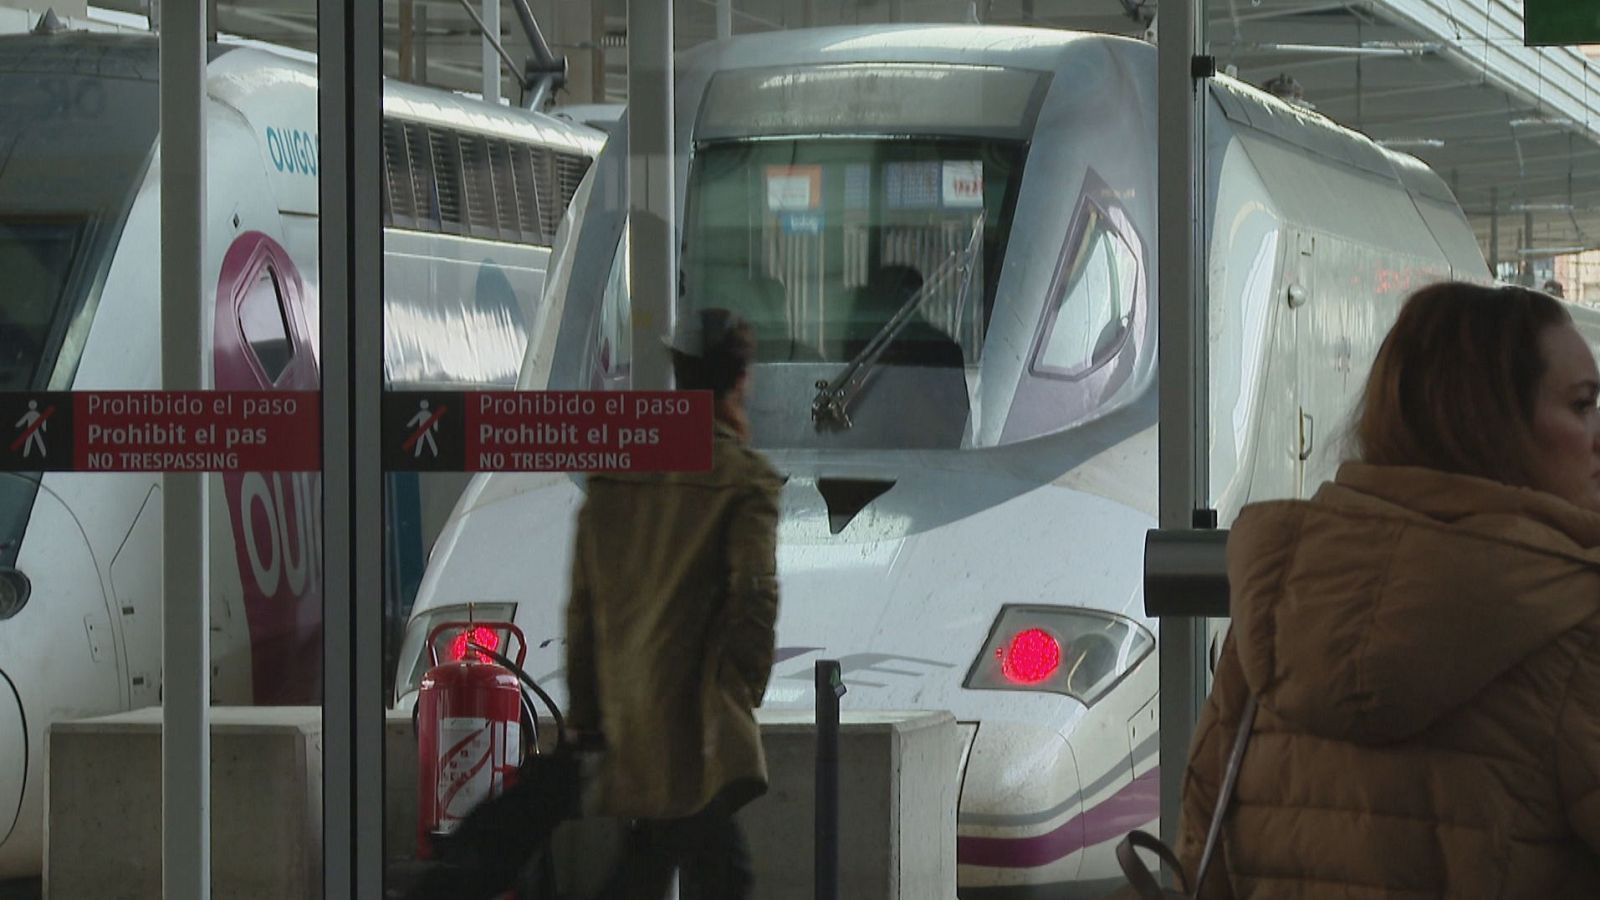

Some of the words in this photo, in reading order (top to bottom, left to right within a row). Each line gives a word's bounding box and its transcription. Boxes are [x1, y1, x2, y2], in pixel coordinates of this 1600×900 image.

[266, 126, 319, 176] OUIGO
[87, 394, 203, 416] Prohibido
[213, 394, 232, 416] el
[243, 398, 297, 420] paso
[479, 394, 596, 416] Prohibido
[605, 394, 625, 416] el
[636, 398, 690, 419] paso
[87, 423, 186, 445] Prohibit
[194, 423, 215, 445] el
[226, 427, 267, 448] pas
[479, 423, 578, 445] Prohibit
[587, 423, 607, 445] el
[618, 427, 660, 448] pas
[87, 452, 113, 469] NO
[120, 452, 239, 469] TRESPASSING
[479, 452, 505, 469] NO
[511, 452, 631, 469] TRESPASSING
